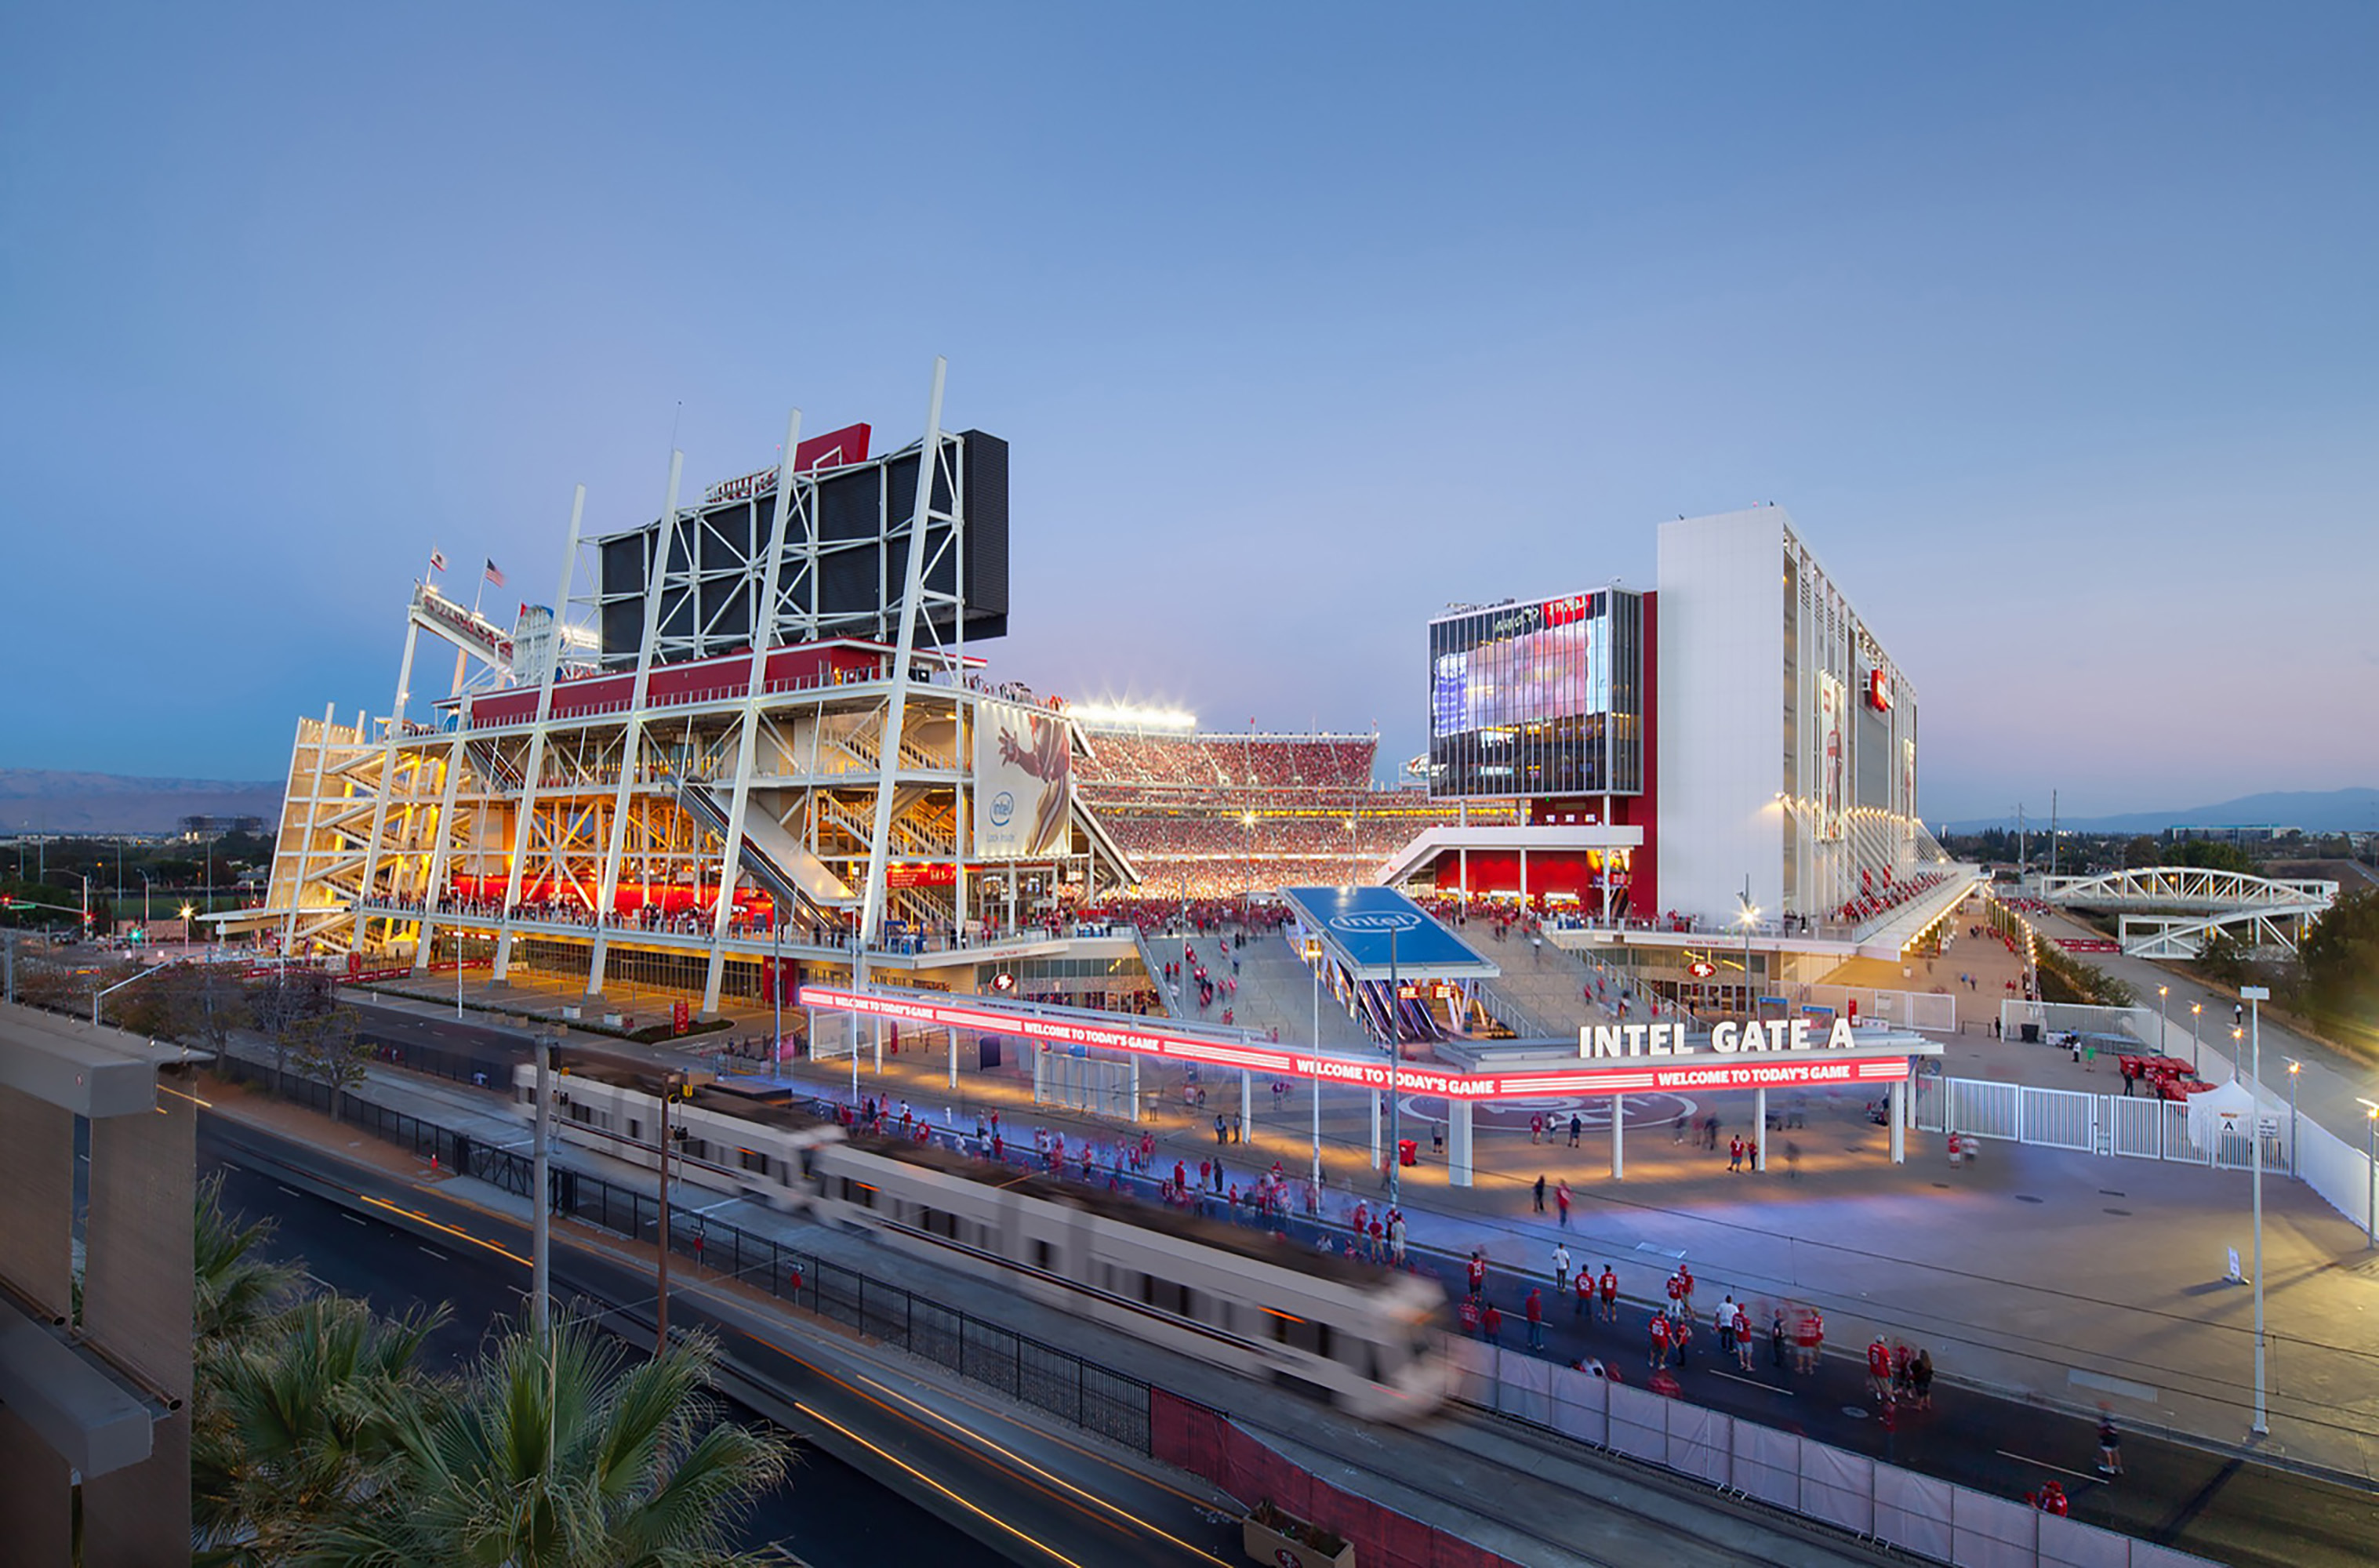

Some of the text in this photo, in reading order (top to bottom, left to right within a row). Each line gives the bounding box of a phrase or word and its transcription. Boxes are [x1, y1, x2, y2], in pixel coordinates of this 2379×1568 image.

[1024, 1022, 1160, 1051] WELCOME TO TODAY'S GAME
[1579, 1018, 1855, 1058] INTEL GATE A
[1296, 1059, 1495, 1094] WELCOME TO TODAY'S GAME
[1658, 1065, 1851, 1086] WELCOME TO TODAY'S GAME
